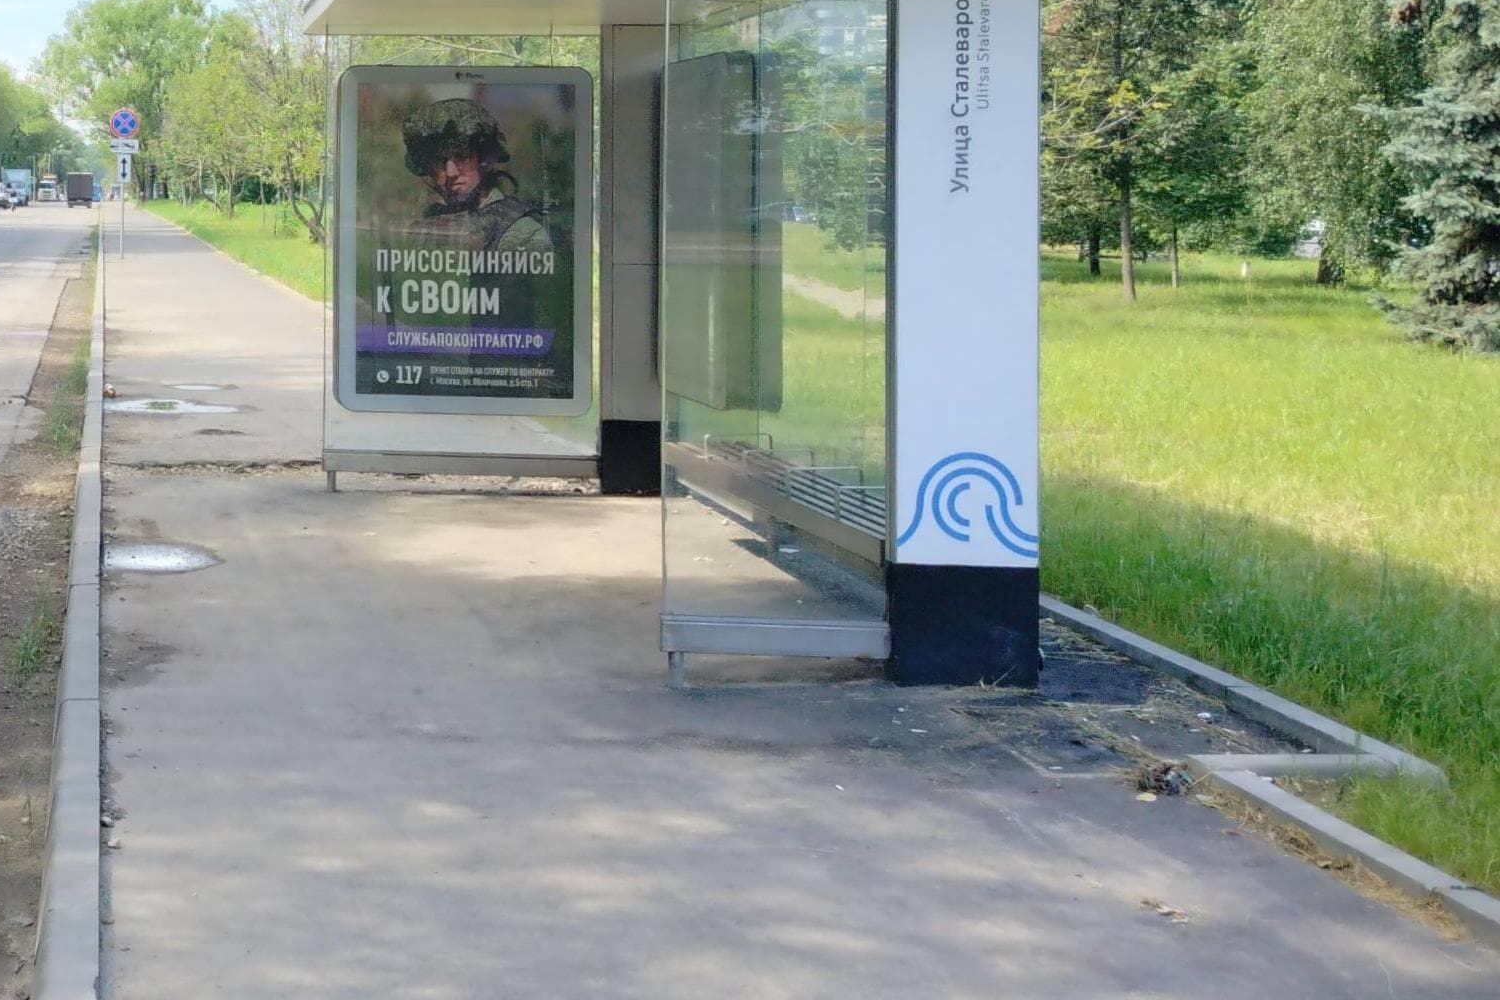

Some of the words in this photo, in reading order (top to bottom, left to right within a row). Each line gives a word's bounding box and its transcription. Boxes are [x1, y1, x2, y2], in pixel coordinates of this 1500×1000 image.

[976, 65, 990, 110] Ulitsa
[950, 124, 972, 193] Улица
[376, 247, 555, 276] ПРИСОЕДИНЯЙСЯ
[387, 331, 544, 350] СЛУЖБАПОКОНТРАКТУ.РФ
[395, 365, 424, 385] 117
